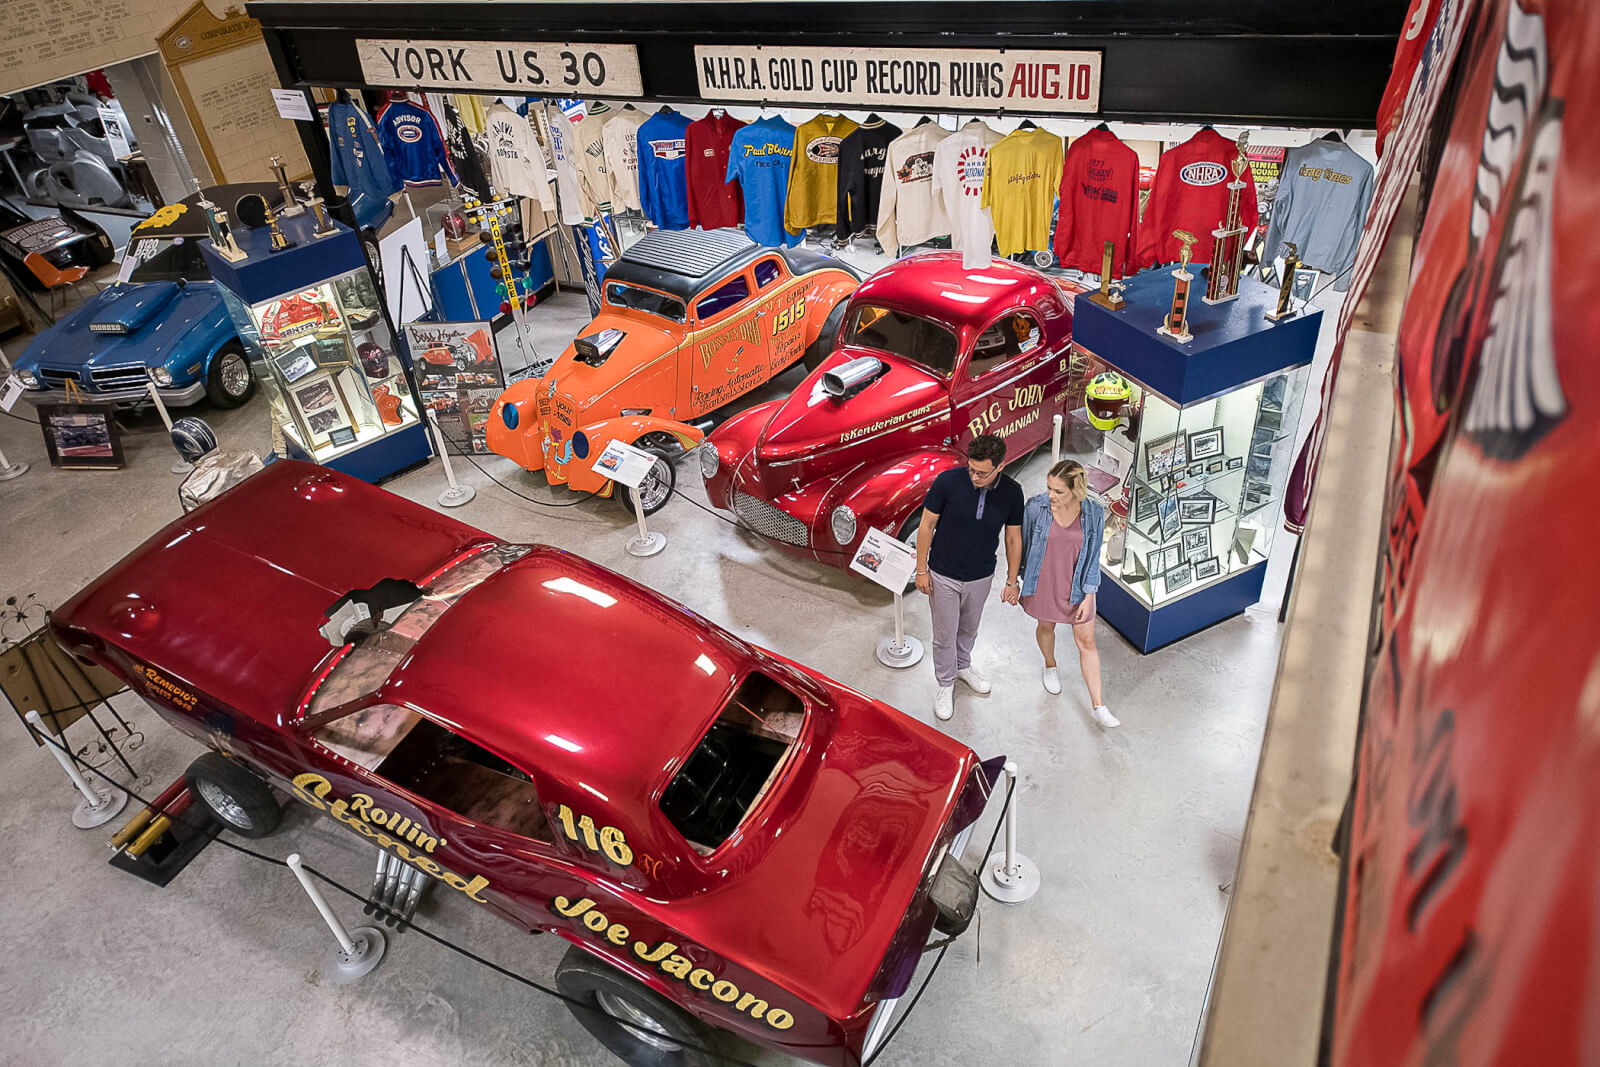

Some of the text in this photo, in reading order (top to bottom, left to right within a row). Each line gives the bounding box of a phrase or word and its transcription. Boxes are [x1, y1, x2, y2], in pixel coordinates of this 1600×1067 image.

[380, 47, 606, 87] YORK U.S. 30
[702, 56, 767, 92] N.H.R.A.
[769, 57, 814, 92] GOLD
[821, 58, 858, 94] CUP
[866, 60, 941, 96] RECORD
[949, 61, 1004, 98] RUNS
[1068, 64, 1092, 101] 10
[392, 114, 422, 127] ADVISOR
[743, 143, 767, 157] Paul
[1188, 167, 1219, 181] NHRA
[133, 248, 158, 260] PRO
[772, 296, 806, 337] 1515
[967, 401, 1002, 439] BIG
[1008, 384, 1047, 411] JOHN
[292, 773, 490, 904] Stoned
[350, 793, 448, 854] Rollin'
[557, 804, 634, 867] 116
[554, 895, 630, 946] Joe
[633, 941, 795, 1030] Jacono
